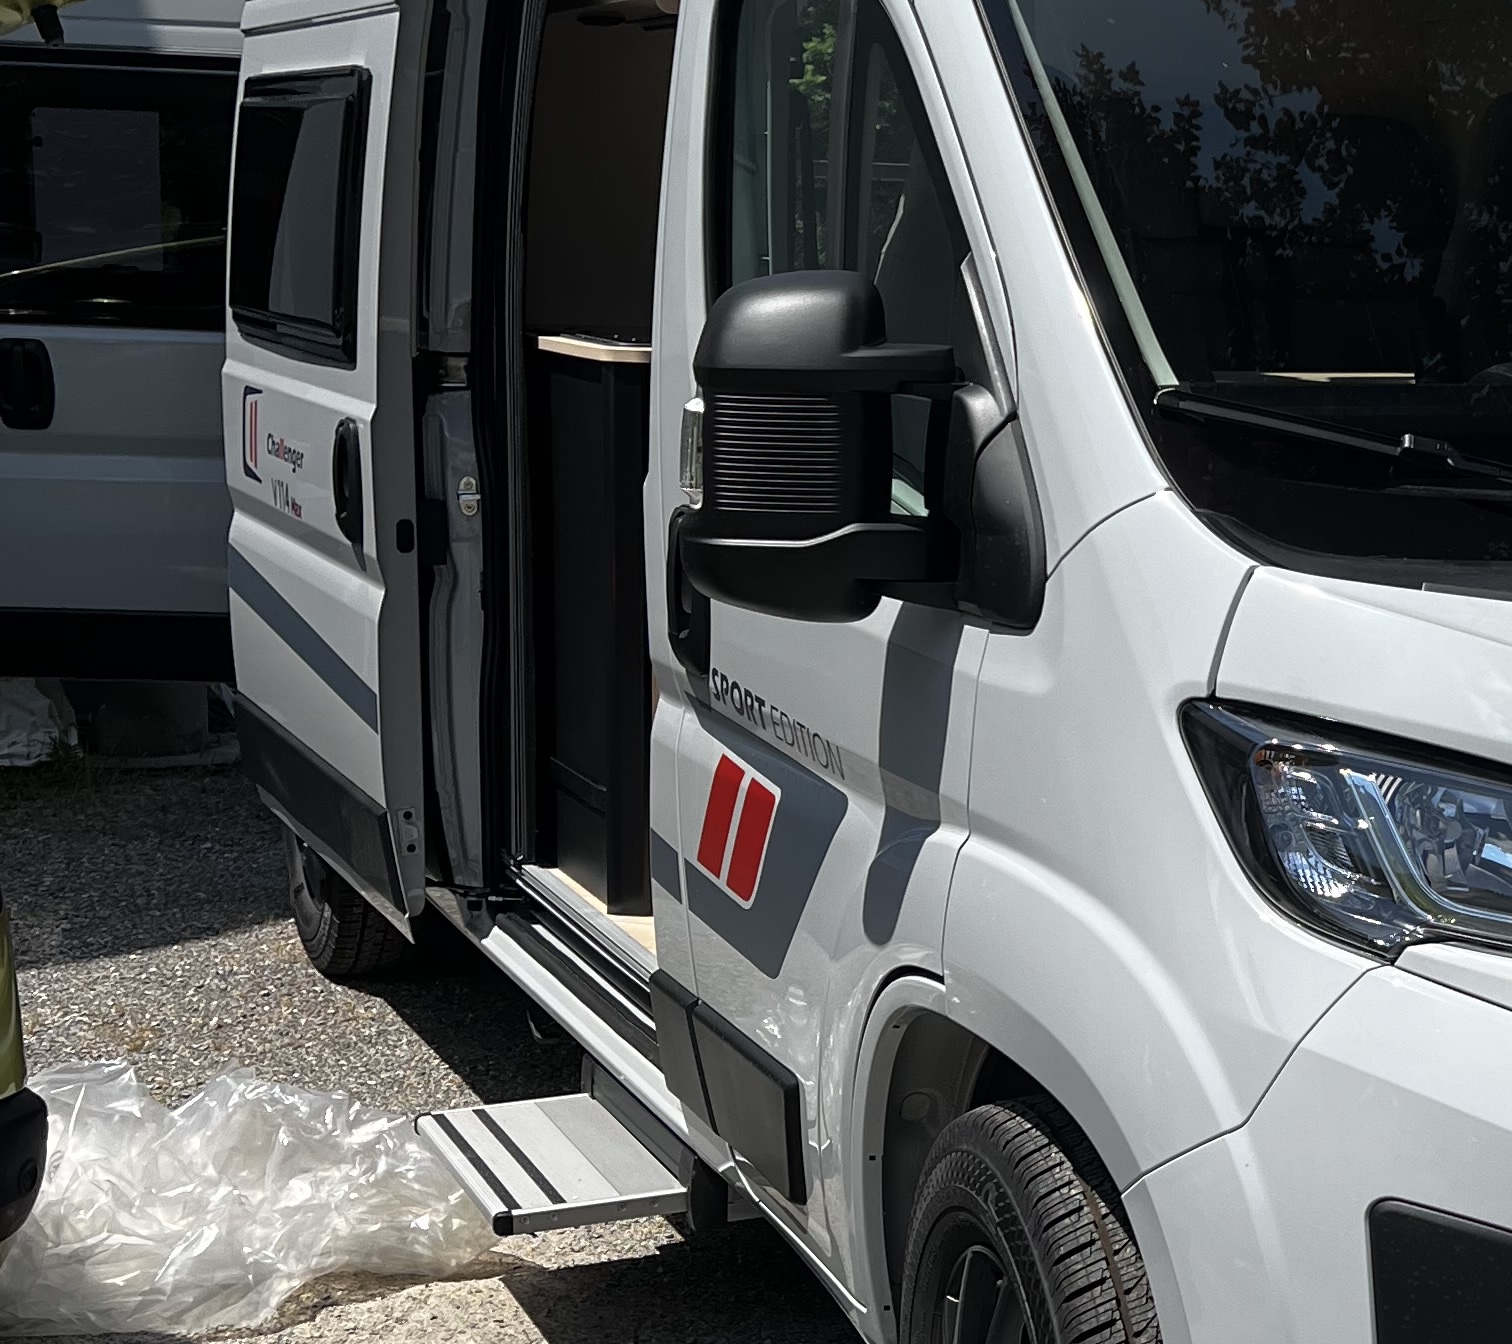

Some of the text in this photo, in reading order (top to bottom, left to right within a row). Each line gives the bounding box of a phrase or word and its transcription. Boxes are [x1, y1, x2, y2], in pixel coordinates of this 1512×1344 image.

[266, 432, 304, 474] Challenger
[711, 667, 846, 781] SPORT EDITION
